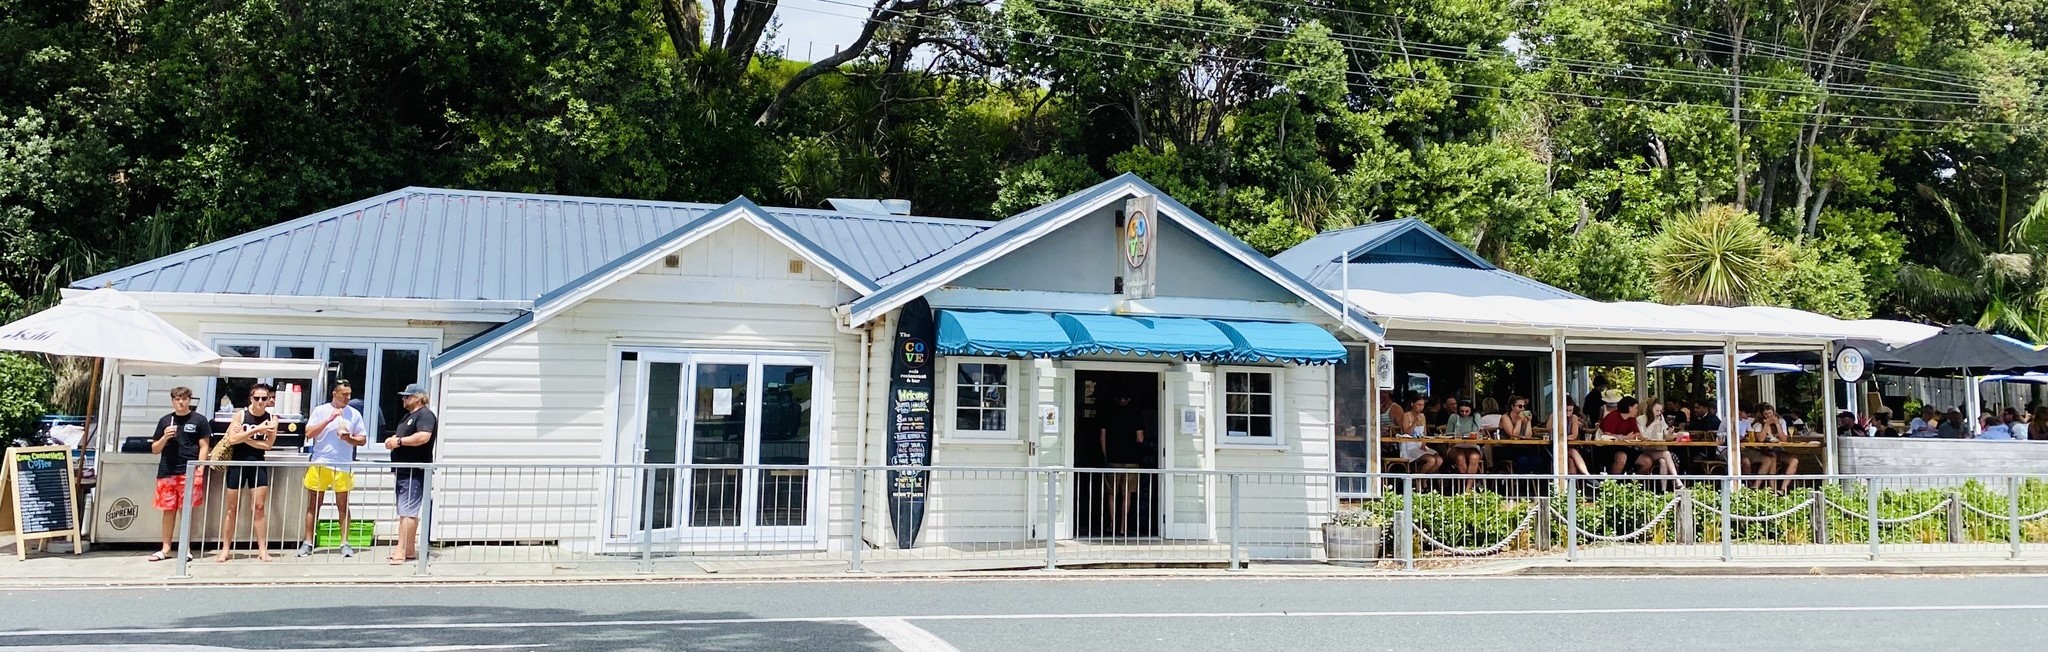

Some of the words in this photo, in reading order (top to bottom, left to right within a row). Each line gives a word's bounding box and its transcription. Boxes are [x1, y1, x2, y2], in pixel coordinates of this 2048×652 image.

[905, 342, 925, 352] CO
[905, 352, 924, 363] VE
[1843, 355, 1857, 364] CO
[27, 459, 53, 469] Coffee
[108, 507, 136, 521] SUPREME
